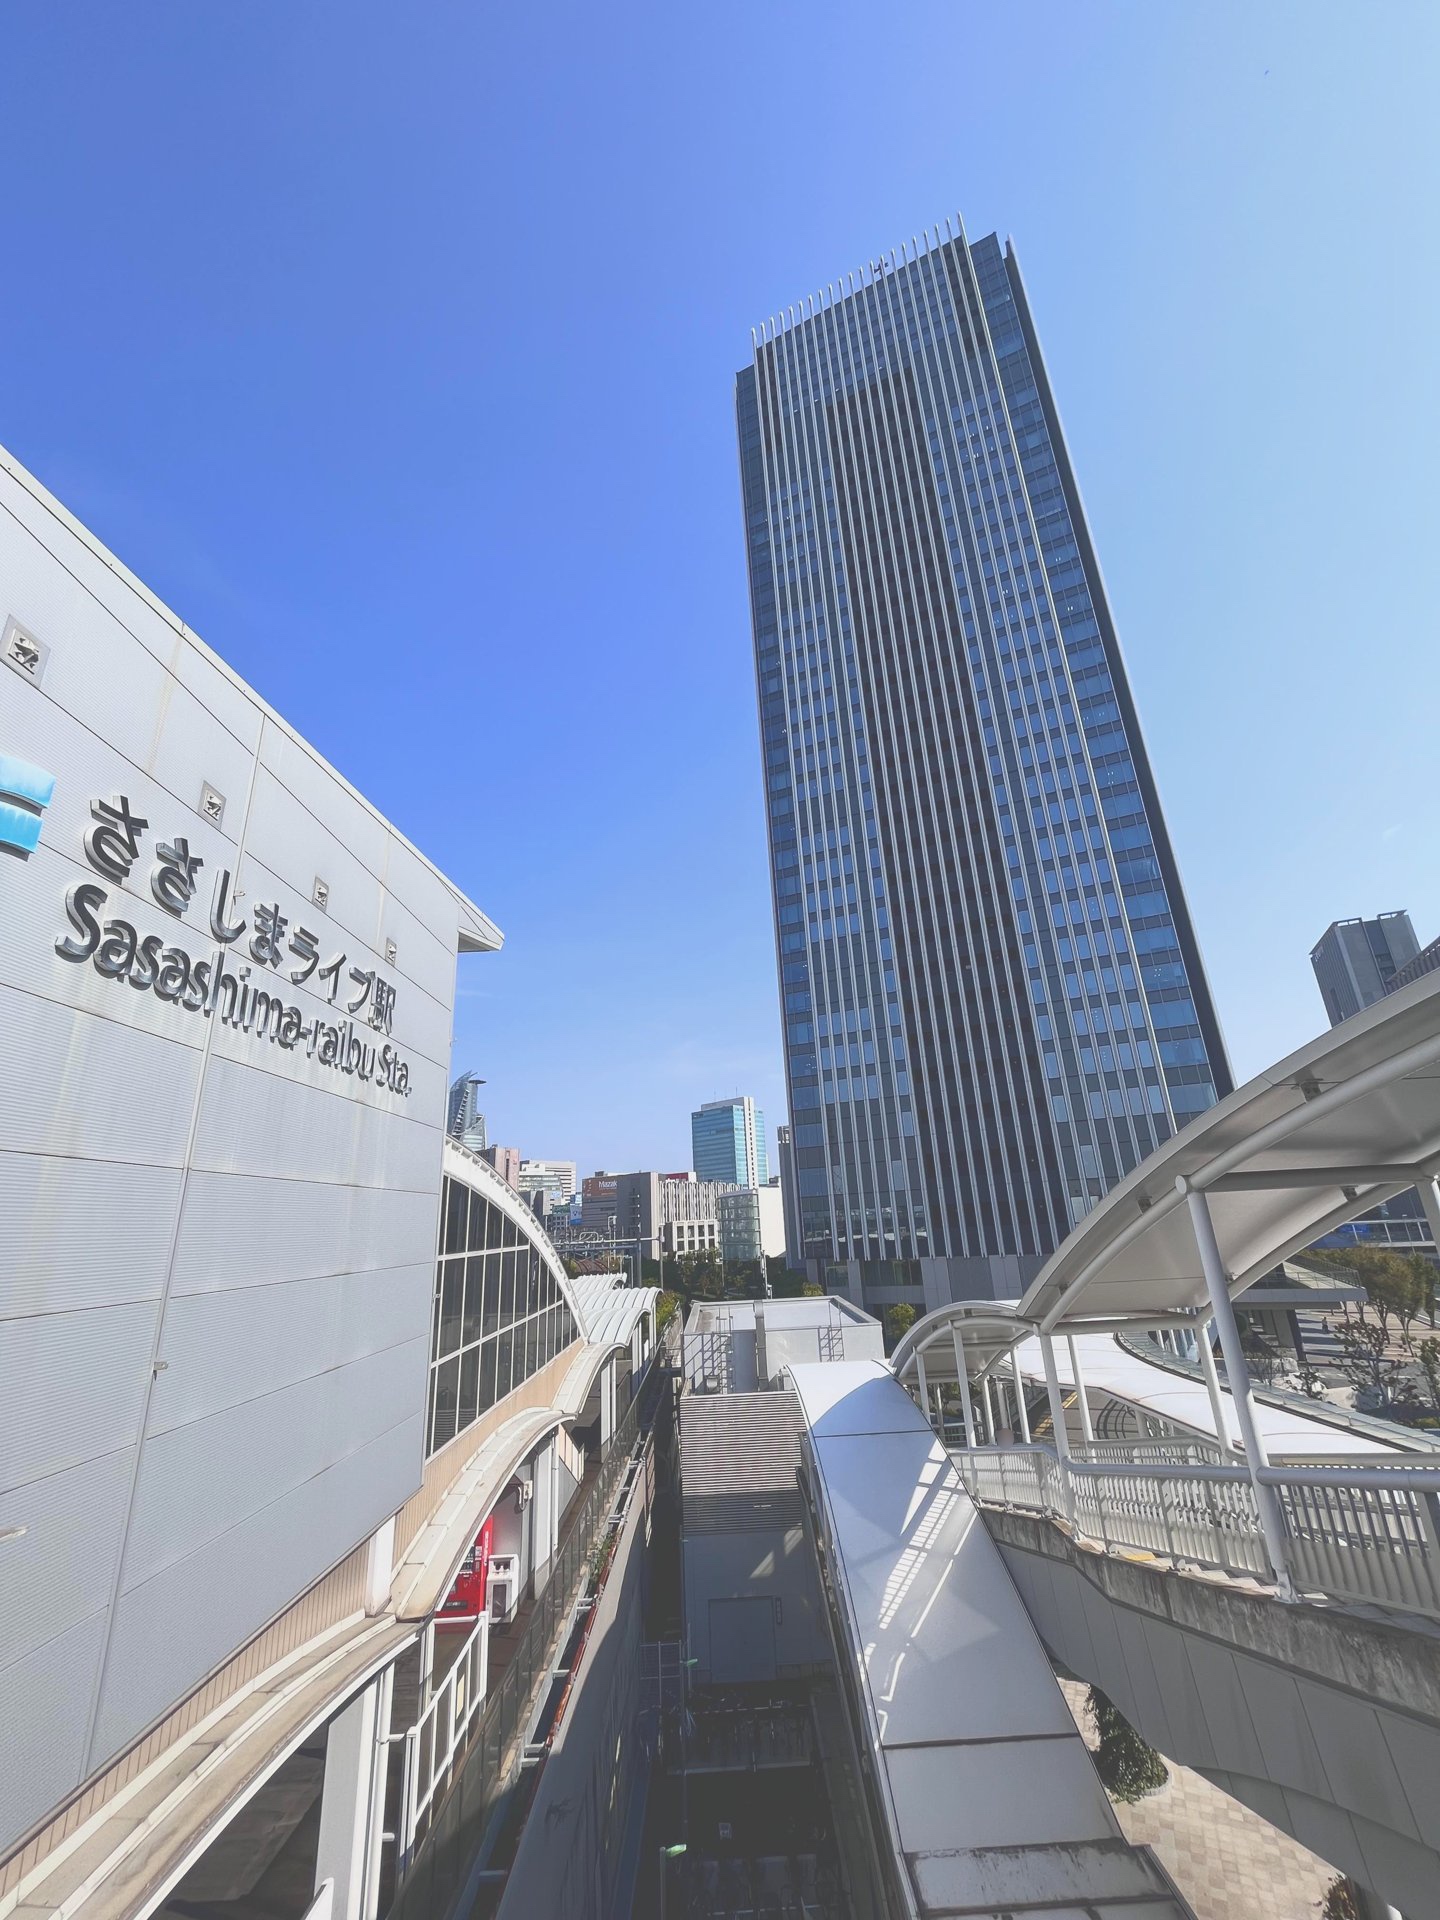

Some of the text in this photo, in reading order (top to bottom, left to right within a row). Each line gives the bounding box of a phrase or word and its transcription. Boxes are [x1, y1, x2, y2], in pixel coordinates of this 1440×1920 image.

[55, 884, 412, 1098] Sasashima-raibu Sta.
[598, 1180, 617, 1189] Mazak
